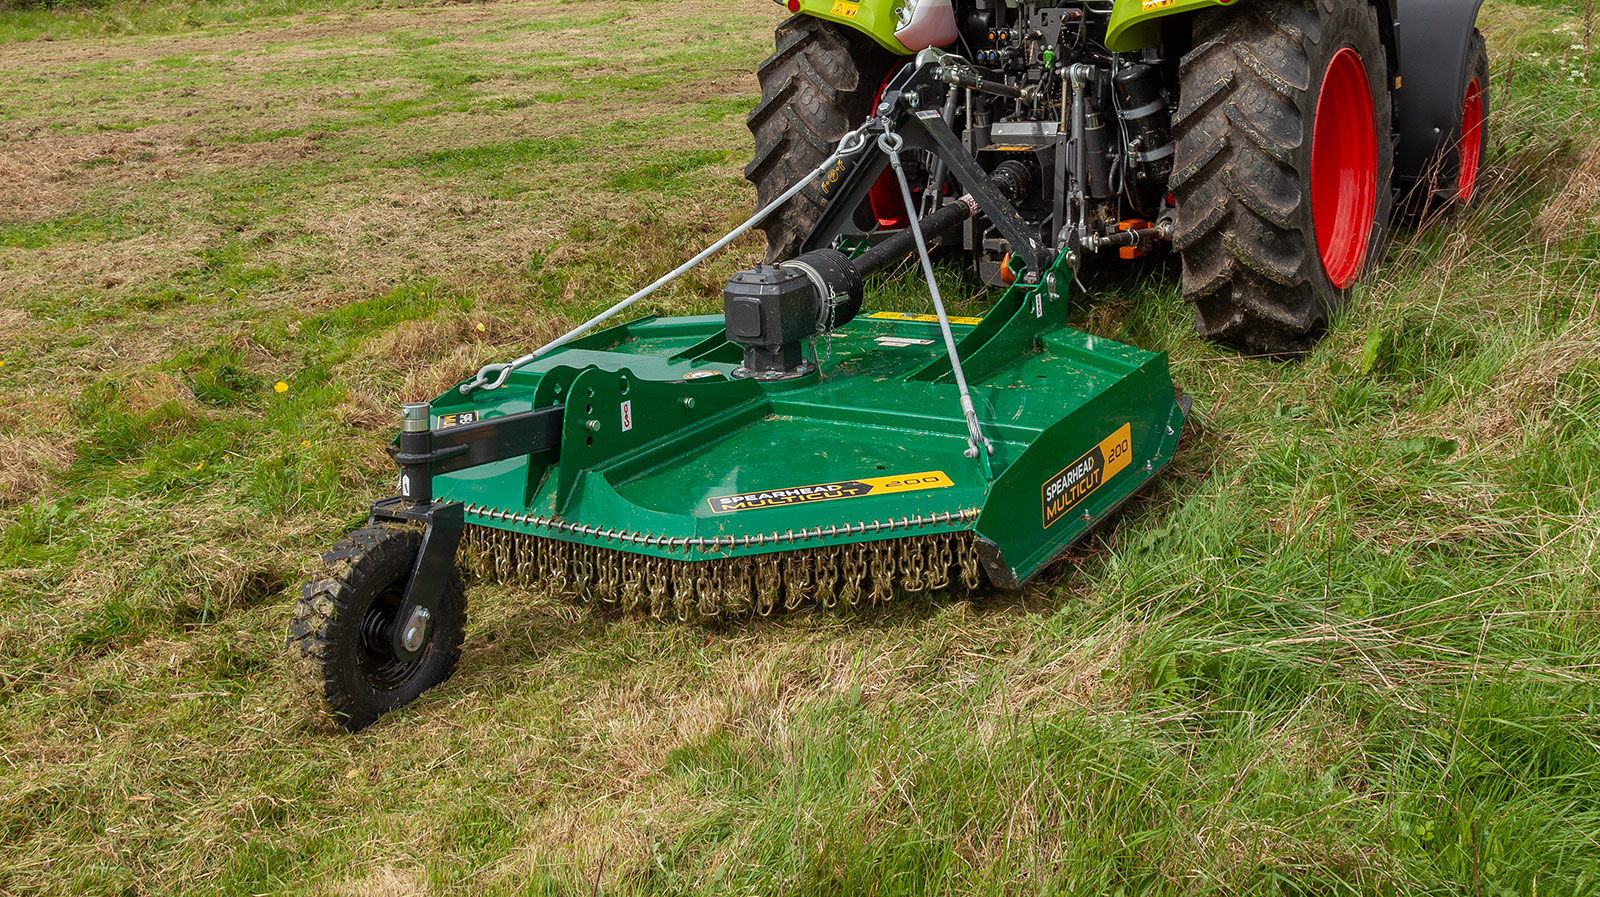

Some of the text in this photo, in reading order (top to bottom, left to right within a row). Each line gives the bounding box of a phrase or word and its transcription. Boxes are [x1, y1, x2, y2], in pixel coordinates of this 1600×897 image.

[1108, 439, 1129, 465] 200
[885, 476, 940, 488] 200
[1046, 456, 1095, 502] SPEARHEAD
[719, 485, 843, 505] SPEARHEAD
[721, 488, 859, 511] MULTICUT
[1046, 468, 1100, 521] MULTICUT
